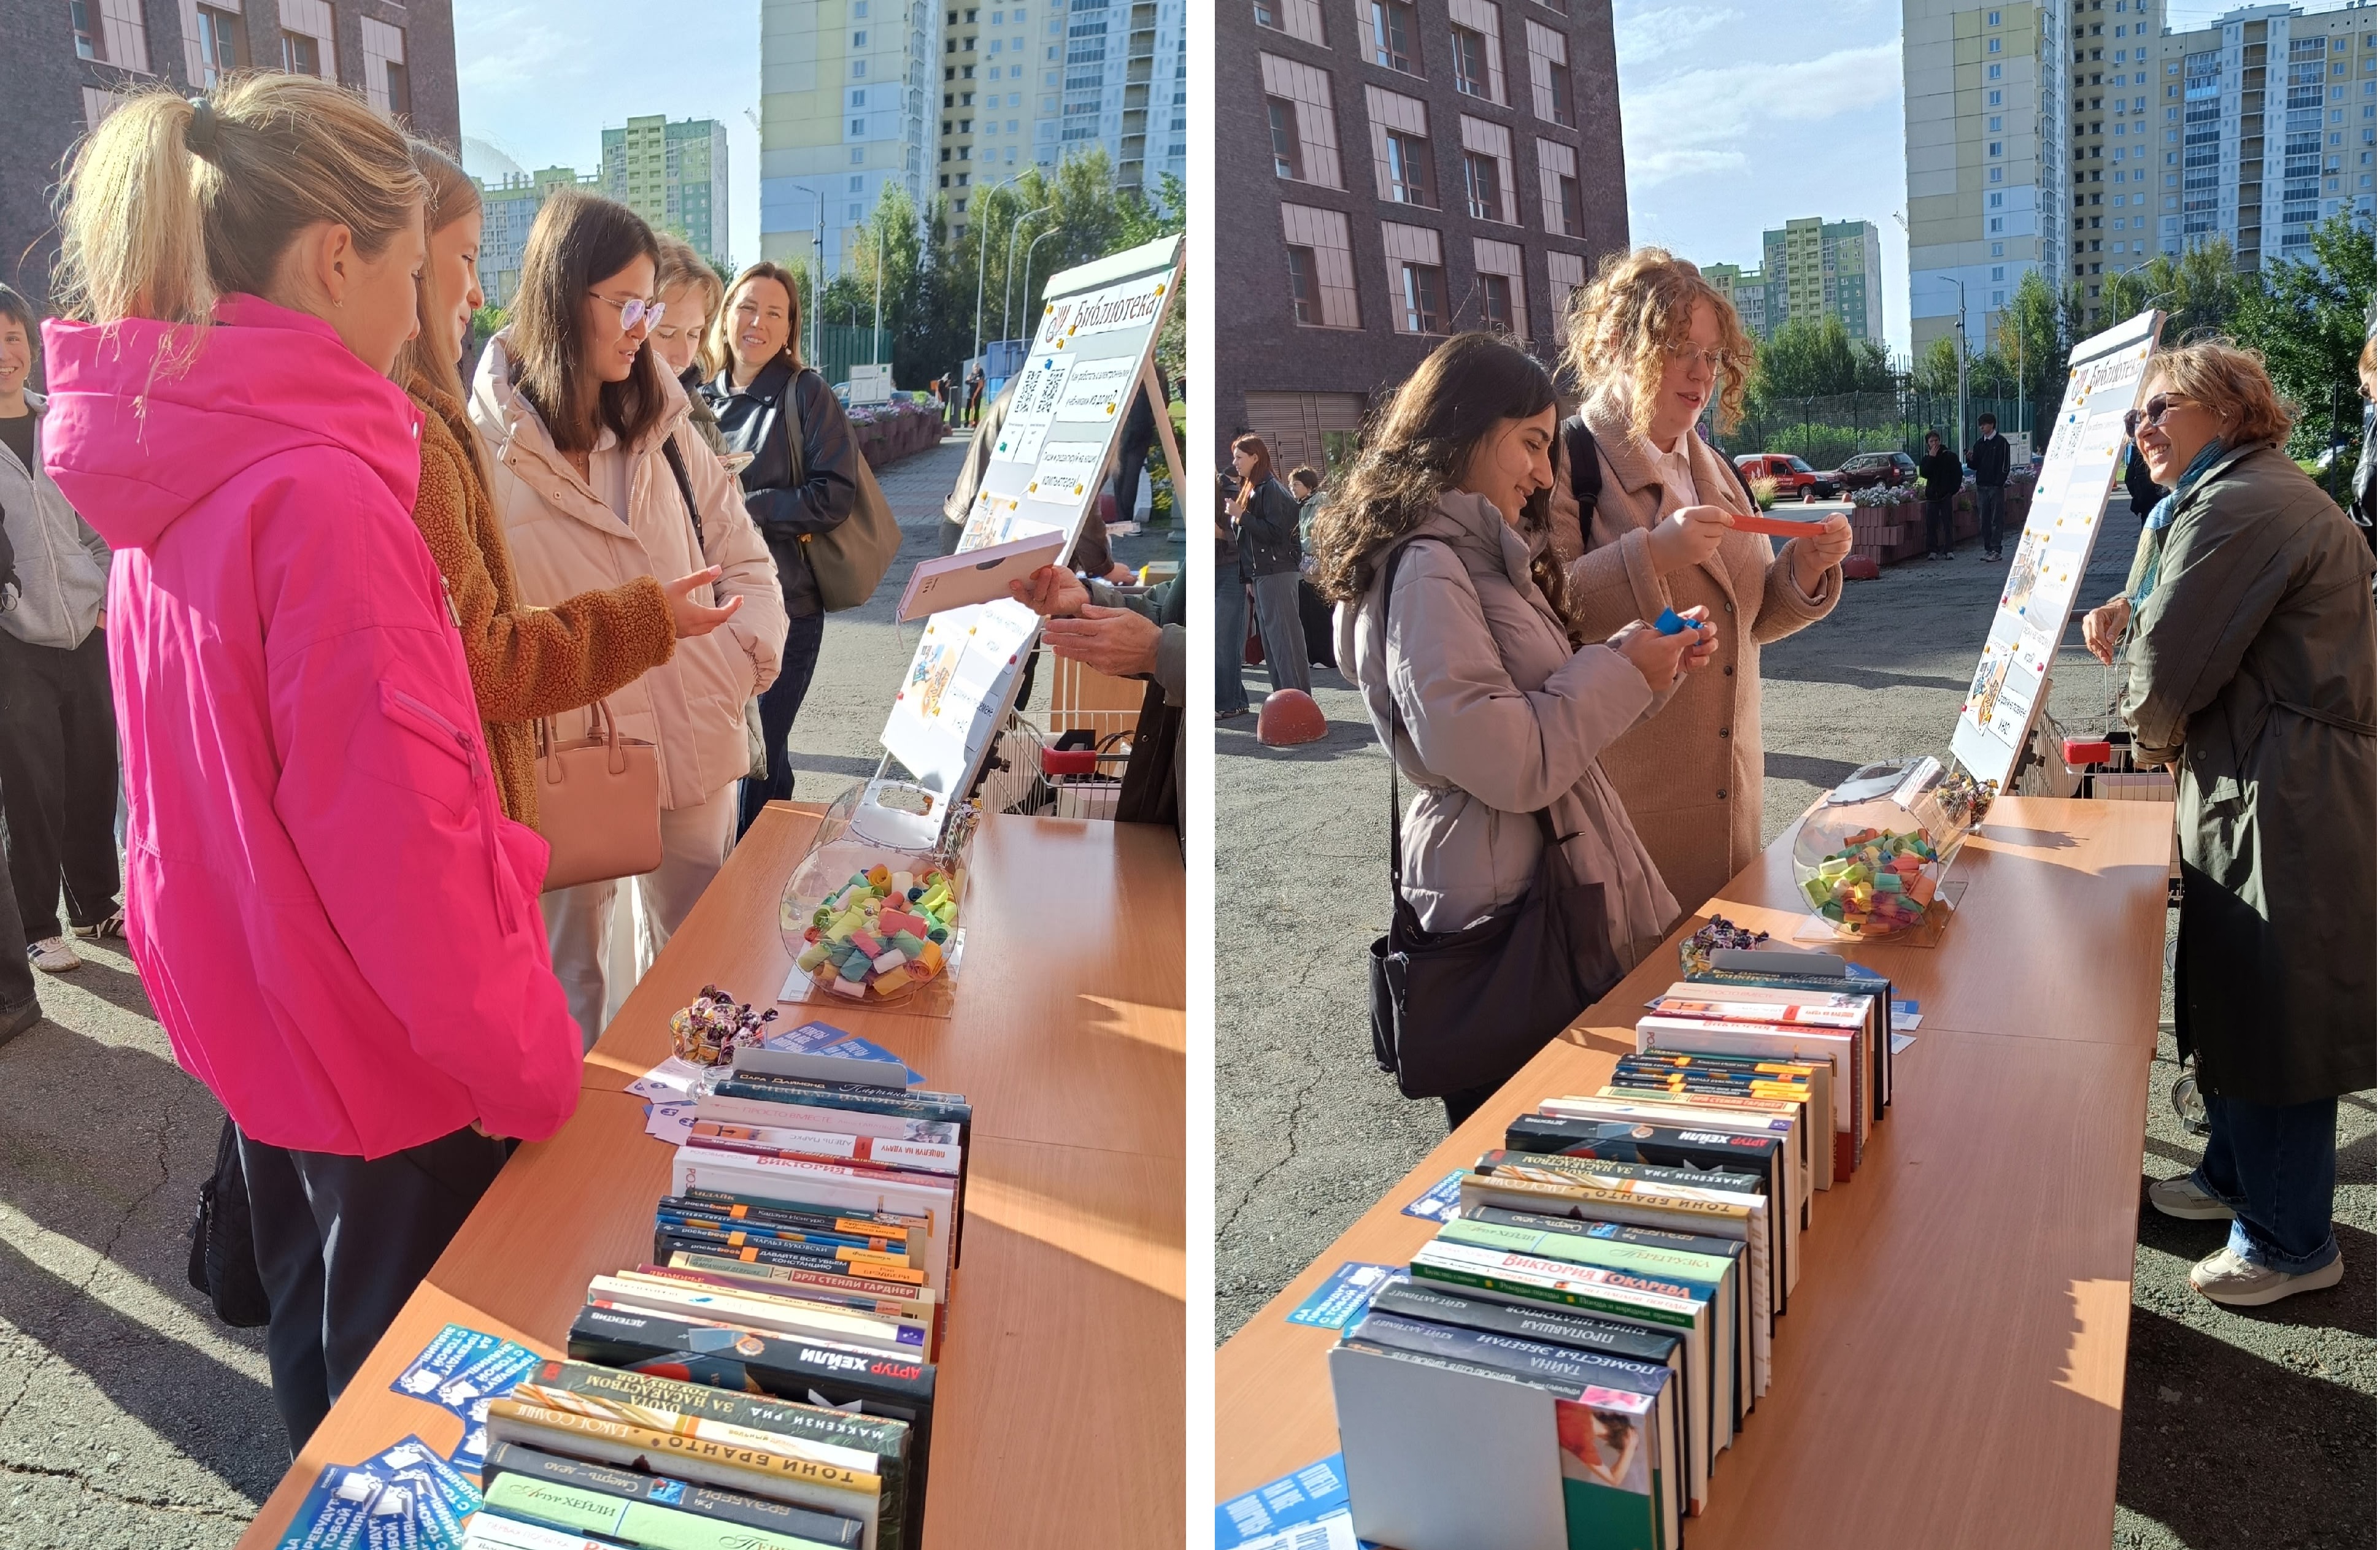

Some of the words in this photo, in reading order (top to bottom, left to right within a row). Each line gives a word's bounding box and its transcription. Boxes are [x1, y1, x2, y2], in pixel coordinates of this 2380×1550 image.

[1075, 293, 1157, 328] Библиотека
[797, 1035, 814, 1045] ВСЕ
[799, 1026, 830, 1040] ОТВЕТЫ
[771, 1037, 808, 1053] ВОПРОСЫ
[840, 1042, 871, 1057] ОТВЕТЫ
[839, 1083, 911, 1099] Паутина
[1709, 1097, 1741, 1105] СТЕНЛИ
[742, 1107, 788, 1118] ПРОСТО
[789, 1111, 834, 1124] ВМЕСТЕ
[1525, 1117, 1567, 1126] ДЕТЕКТИВ
[789, 1134, 821, 1143] ПАРКС
[823, 1137, 853, 1146] АДЕЛЬ
[1677, 1130, 1730, 1145] ХЕЙЛИ
[1730, 1137, 1770, 1148] АРТУР
[880, 1145, 903, 1154] УДАЧУ
[915, 1148, 946, 1159] ПОЦЕЛУЙ
[756, 1154, 846, 1175] ВИКТОРИЯ
[1522, 1156, 1612, 1173] НАСЛЕДСТВОМ
[1616, 1166, 1633, 1175] ЗА
[1644, 1168, 1669, 1178] РИД
[1675, 1173, 1744, 1185] МАККЕНЗИ
[691, 1190, 735, 1201] АПДАЙК
[1595, 1190, 1670, 1205] БРАНТО
[1679, 1200, 1731, 1213] ТОНИ
[757, 1210, 788, 1219] Кадзуо
[788, 1214, 825, 1224] Исигуро
[1545, 1220, 1583, 1232] Смерть
[1496, 1229, 1538, 1242] ХЕЙЛИ
[753, 1237, 782, 1247] ЧАРЛЬЗ
[783, 1241, 828, 1253] БУКОВСКИ
[759, 1250, 799, 1260] ДАВАЙТЕ
[818, 1258, 847, 1267] УБЬЕМ
[771, 1257, 833, 1270] КОНСТАНЦИЮ
[1609, 1248, 1710, 1268] ПЕРЕГРУЗКА
[698, 1262, 730, 1272] МРАЧНОЙ
[730, 1266, 761, 1275] ДЕВУШКЕ
[863, 1270, 911, 1281] БРЭДБЕРИ
[1502, 1253, 1597, 1281] ВИКТОРИЯ
[1600, 1269, 1690, 1299] ТОКАРЕВА
[794, 1272, 816, 1282] ЭРЛ
[817, 1275, 861, 1289] СТЕНЛИ
[863, 1282, 914, 1295] ГАРДНЕР
[1306, 1284, 1349, 1322] ПРЕБУДУТ
[1325, 1289, 1358, 1316] ТОБОЙ
[1388, 1289, 1439, 1303] ЛАТИМЕР
[1438, 1298, 1468, 1308] КЕЙТ
[1499, 1281, 1528, 1294] Рекорды
[1529, 1288, 1560, 1300] погоды
[1579, 1295, 1608, 1308] Погода
[591, 1311, 647, 1327] ДЕТЕКТИВ
[1295, 1308, 1312, 1321] ДА
[1372, 1319, 1422, 1333] ЛАТИМЕР
[1422, 1329, 1454, 1340] КЕЙТ
[1520, 1319, 1615, 1345] ПРОПАВШАЯ
[418, 1326, 456, 1363] ЗНАНИЯ!
[478, 1336, 494, 1349] ДА
[1475, 1334, 1554, 1356] ЭББЕРЛИ
[431, 1337, 461, 1367] ТОБОЙ
[445, 1333, 482, 1376] ПРЕБУДУТ
[465, 1343, 515, 1376] ЗНАНИЯ!
[799, 1348, 869, 1372] ХЕЙЛИ
[475, 1356, 517, 1382] ТОБОЙ
[870, 1361, 922, 1380] АРТУР
[1530, 1356, 1581, 1376] ТАЙНА
[1555, 1349, 1657, 1375] ПОМЕСТЬЯ
[482, 1354, 536, 1393] ПРЕБУДУТ
[585, 1375, 707, 1408] НАСЛЕДСТВОМ
[1546, 1383, 1581, 1395] ГАВАЛЬДА
[630, 1394, 681, 1413] ОХОТА
[712, 1399, 735, 1413] ЗА
[751, 1406, 783, 1421] РИД
[794, 1416, 885, 1440] МАККЕНЗИ
[669, 1436, 770, 1466] БРАНТО
[544, 1462, 577, 1475] дело
[782, 1459, 855, 1483] ТОНИ
[435, 1462, 483, 1503] ЗНАНИЯ!
[588, 1471, 639, 1493] Смерть
[1262, 1478, 1296, 1500] НА
[1298, 1463, 1342, 1499] ОТВЕТЫ
[456, 1501, 471, 1512] С
[563, 1495, 616, 1517] ХЕЙЛИ
[694, 1498, 714, 1510] Рэй
[697, 1487, 791, 1516] БРЭДБЕРИ
[1269, 1488, 1306, 1514] ВСЕ
[417, 1502, 441, 1542] ТОБОЙ
[429, 1497, 465, 1546] ЗНАНИЯ!
[1225, 1494, 1276, 1538] ВОПРОСЫ
[320, 1508, 353, 1550] ТОБОЙ
[336, 1511, 368, 1550] НАНИЯ!
